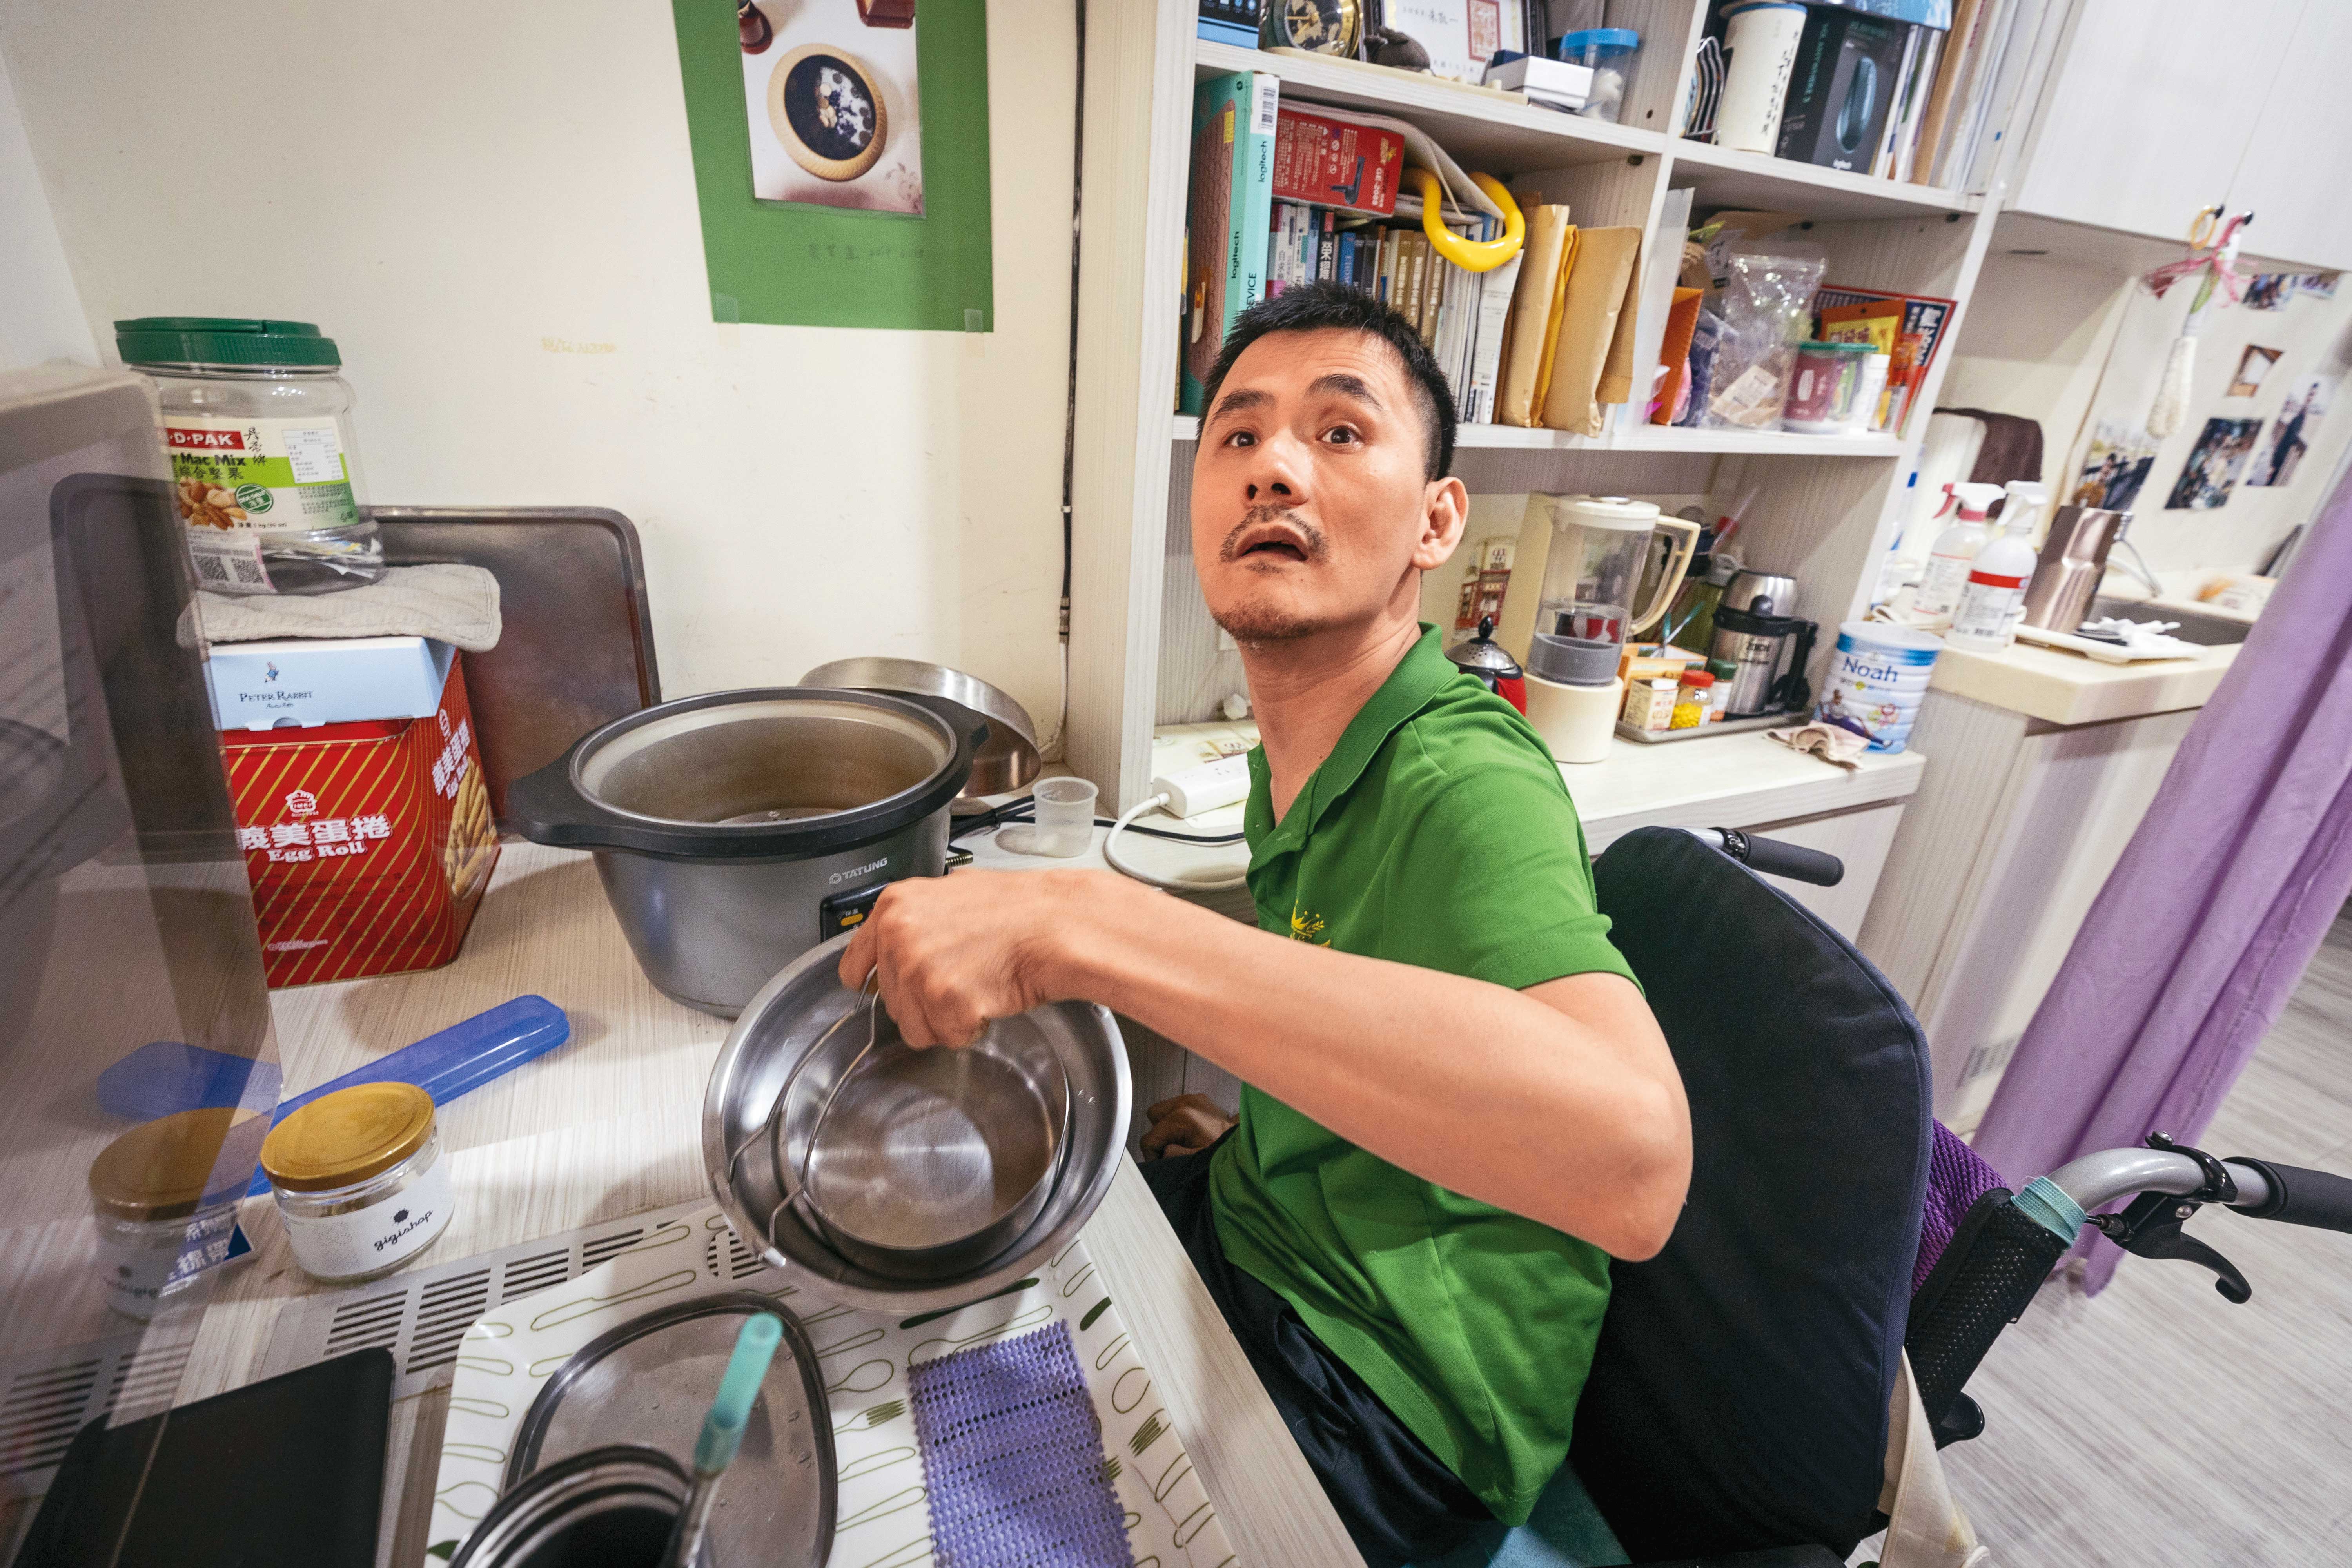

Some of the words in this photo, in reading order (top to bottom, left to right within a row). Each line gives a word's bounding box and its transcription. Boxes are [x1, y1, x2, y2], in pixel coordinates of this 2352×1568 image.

[1258, 140, 1268, 183] logitech
[1231, 231, 1240, 279] logitech
[180, 451, 211, 466] Mac
[214, 454, 247, 466] Mix
[1843, 656, 1900, 683] Noah
[239, 691, 275, 702] PETER
[275, 690, 313, 702] RABBIT
[267, 848, 312, 862] Egg
[316, 841, 365, 858] Roll
[842, 857, 888, 880] TATUNG
[374, 1210, 433, 1252] gigishop
